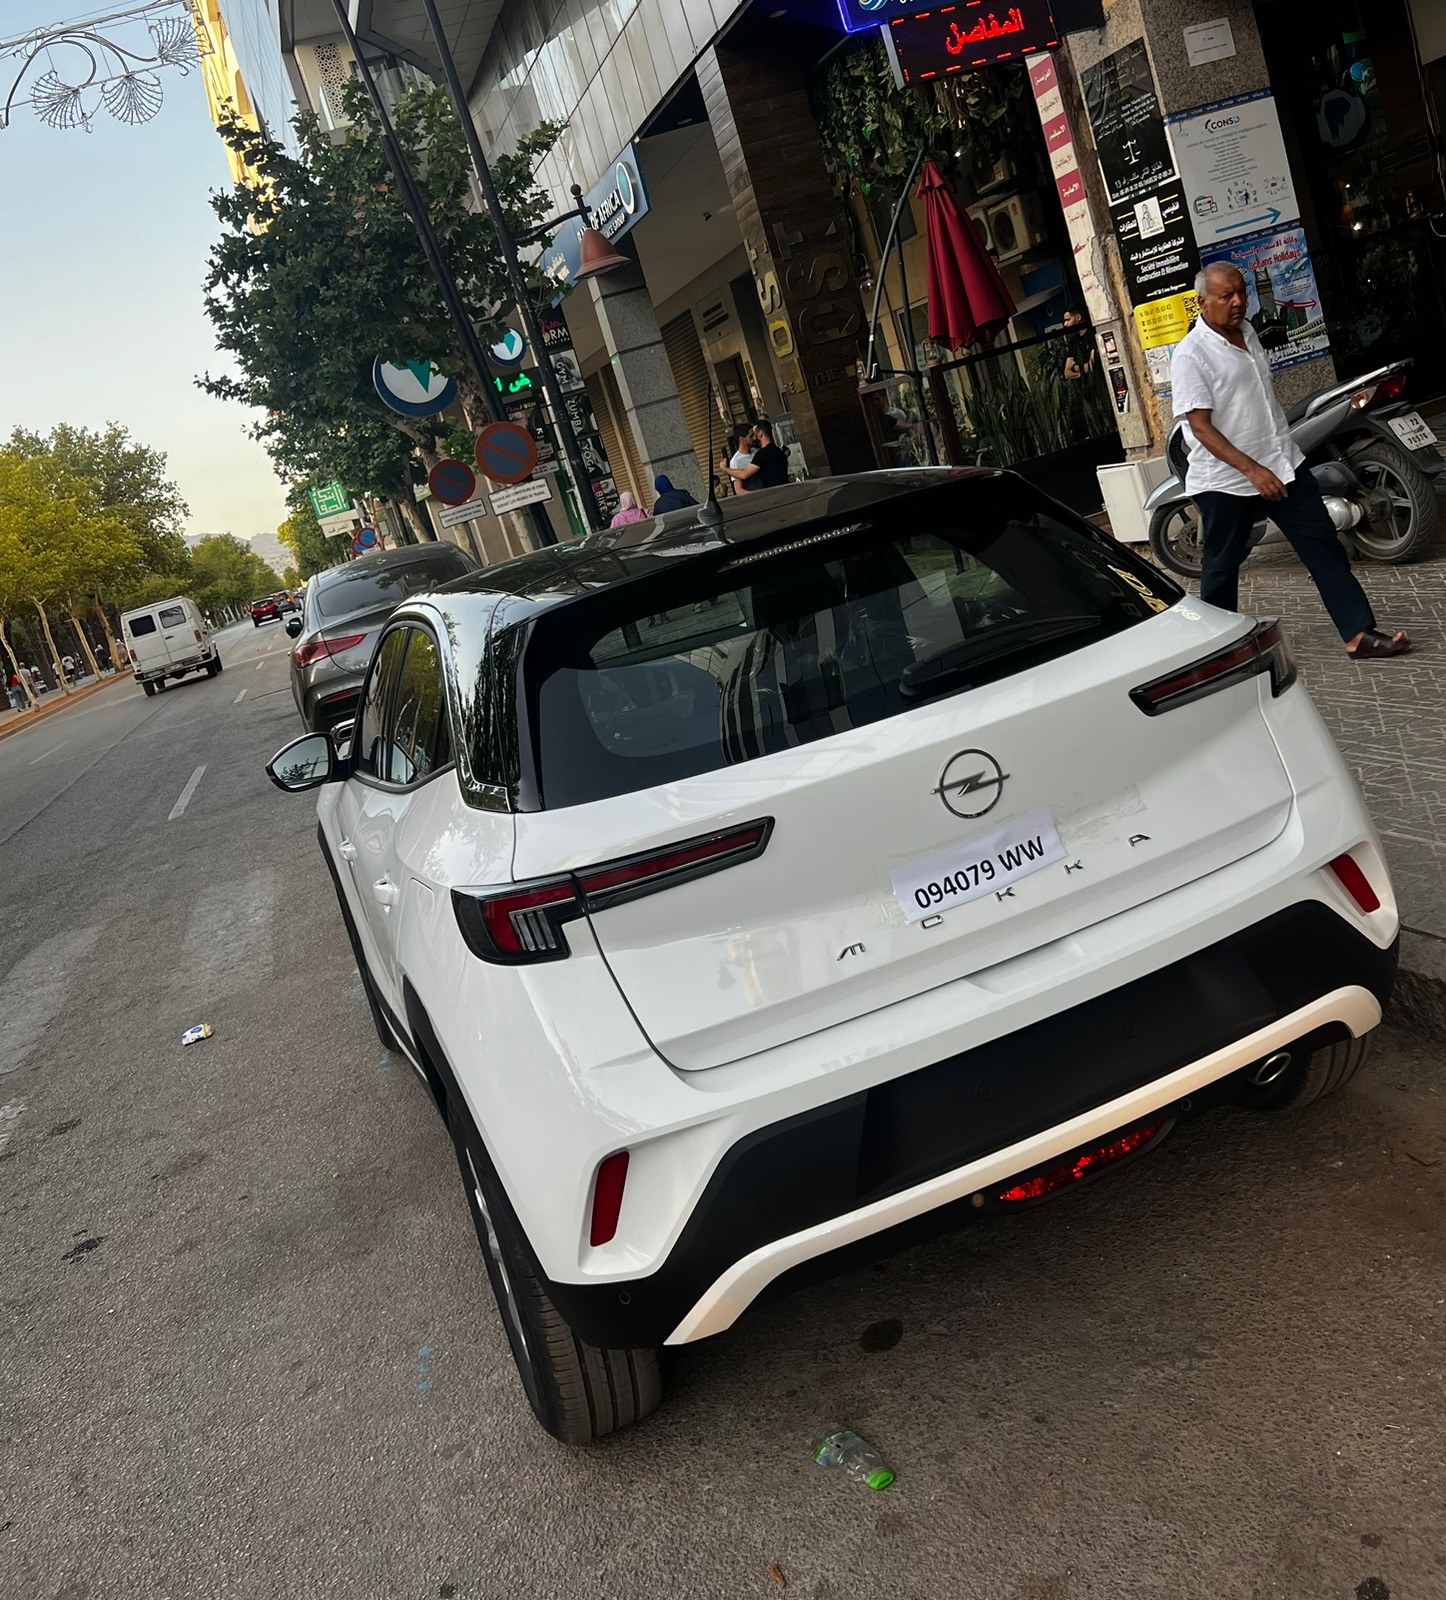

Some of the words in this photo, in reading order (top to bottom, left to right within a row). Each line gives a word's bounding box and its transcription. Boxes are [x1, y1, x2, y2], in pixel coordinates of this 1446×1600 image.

[945, 8, 1025, 54] المفاصل
[1175, 112, 1187, 120] vivo
[1221, 99, 1234, 107] vivo
[1237, 95, 1249, 103] vivo
[590, 211, 600, 230] OF
[598, 189, 621, 225] AFRICA
[1200, 246, 1213, 254] vivo
[1231, 237, 1243, 245] vivo
[1246, 233, 1259, 241] vivo
[1276, 224, 1289, 232] vivo
[1283, 235, 1298, 245] وكالة
[1273, 248, 1301, 263] Holidays
[1137, 271, 1161, 283] Construction
[556, 361, 568, 384] GYM
[566, 398, 585, 434] ZUMBA
[580, 444, 597, 474] YOGA
[595, 489, 609, 512] BIKE
[914, 859, 995, 909] 094079
[998, 836, 1045, 872] WW
